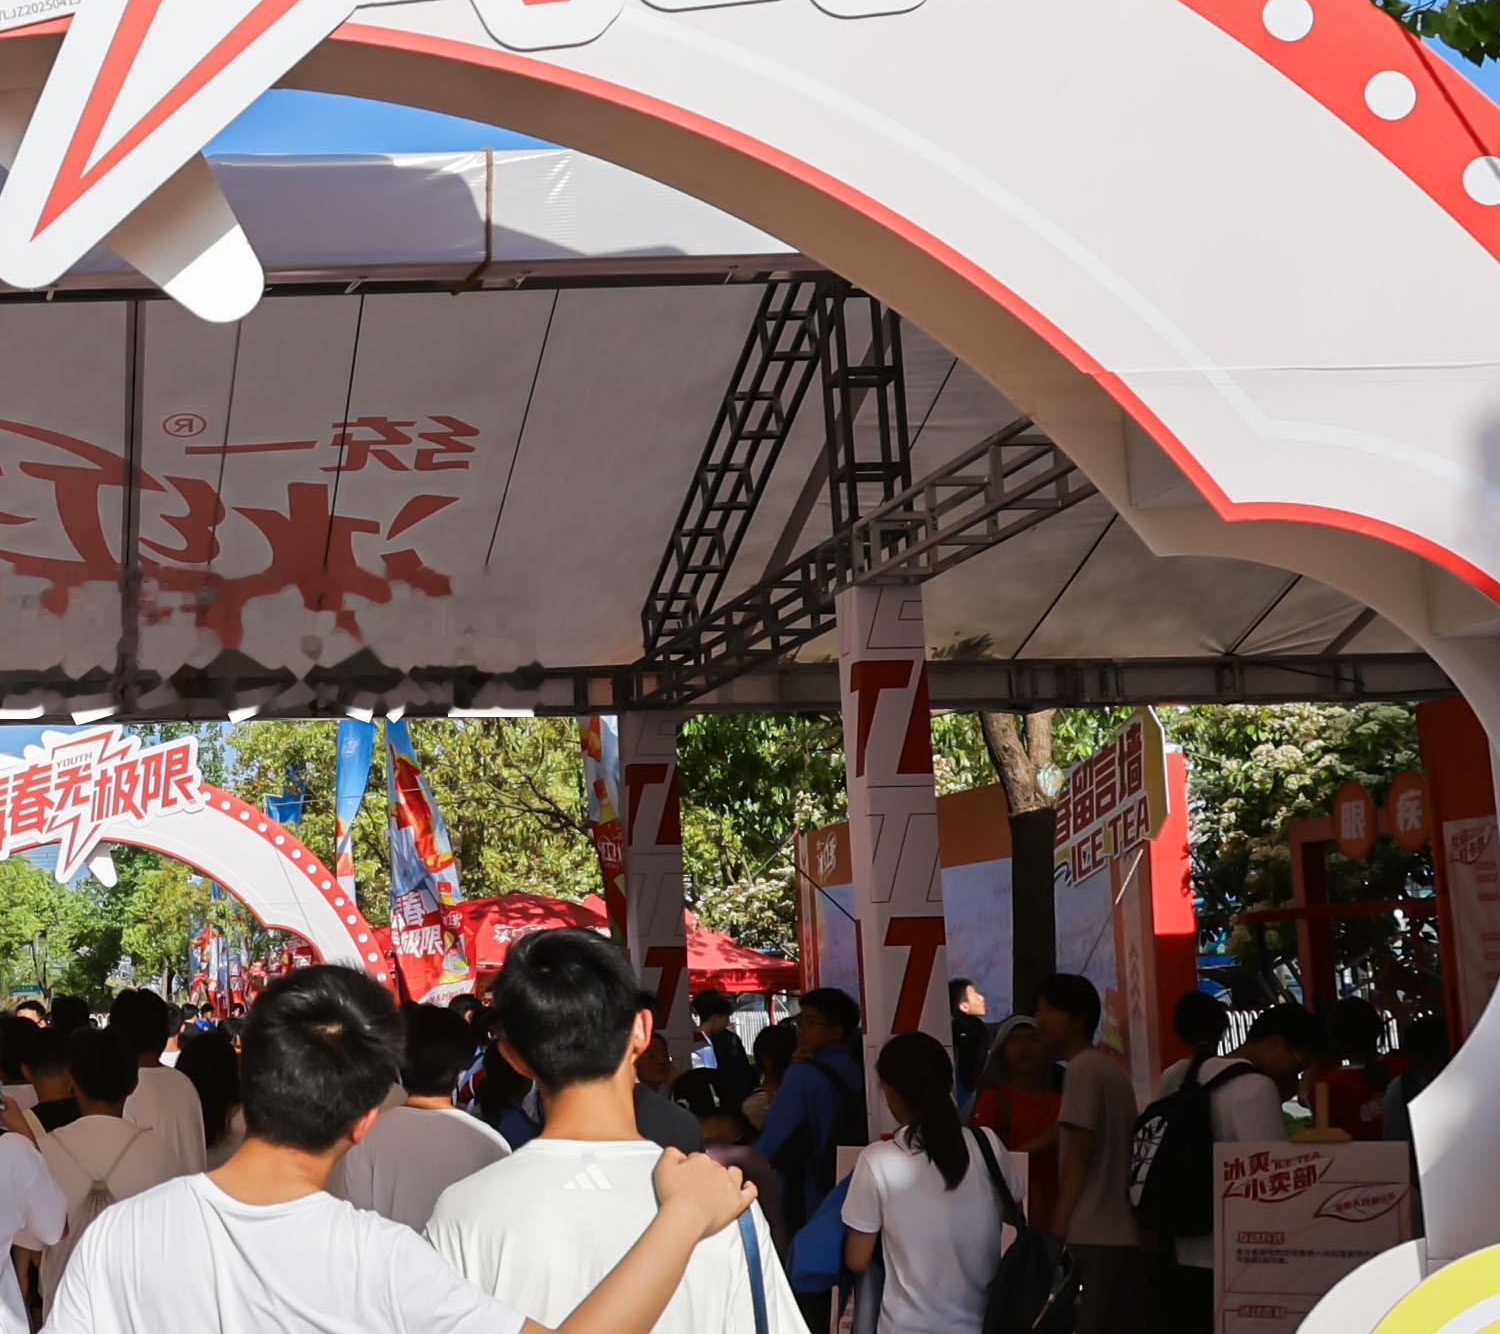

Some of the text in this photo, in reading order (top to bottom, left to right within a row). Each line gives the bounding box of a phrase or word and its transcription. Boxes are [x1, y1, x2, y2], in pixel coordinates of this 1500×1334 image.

[56, 751, 93, 769] YOUTH
[1071, 795, 1150, 883] ICE TEA
[1244, 1164, 1317, 1201] 小卖部
